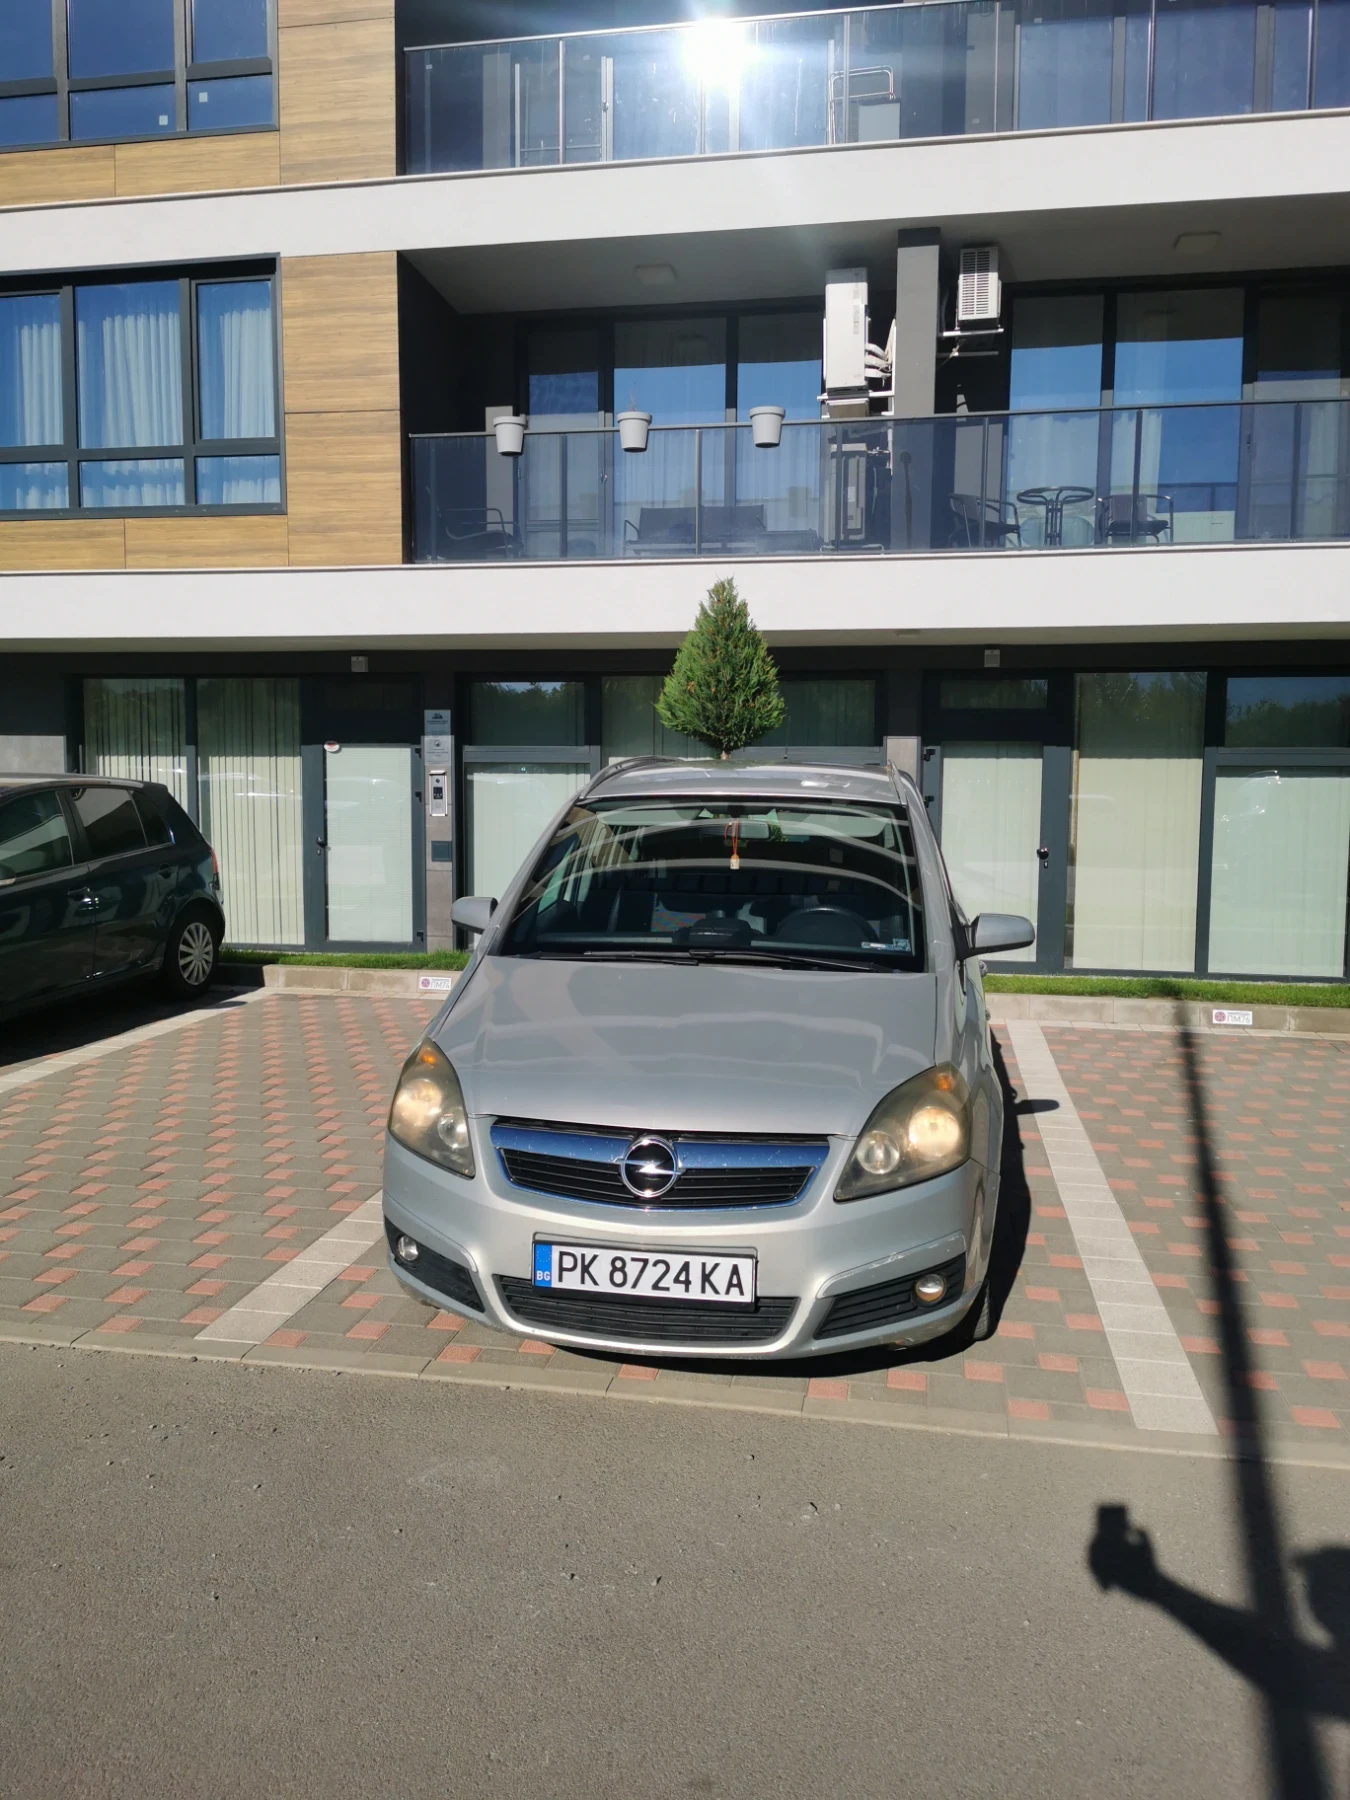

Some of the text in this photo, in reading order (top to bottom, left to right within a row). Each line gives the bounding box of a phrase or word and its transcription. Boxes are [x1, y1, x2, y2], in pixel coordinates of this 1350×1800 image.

[536, 1270, 551, 1281] BG
[558, 1251, 744, 1296] PK 8724 KA
